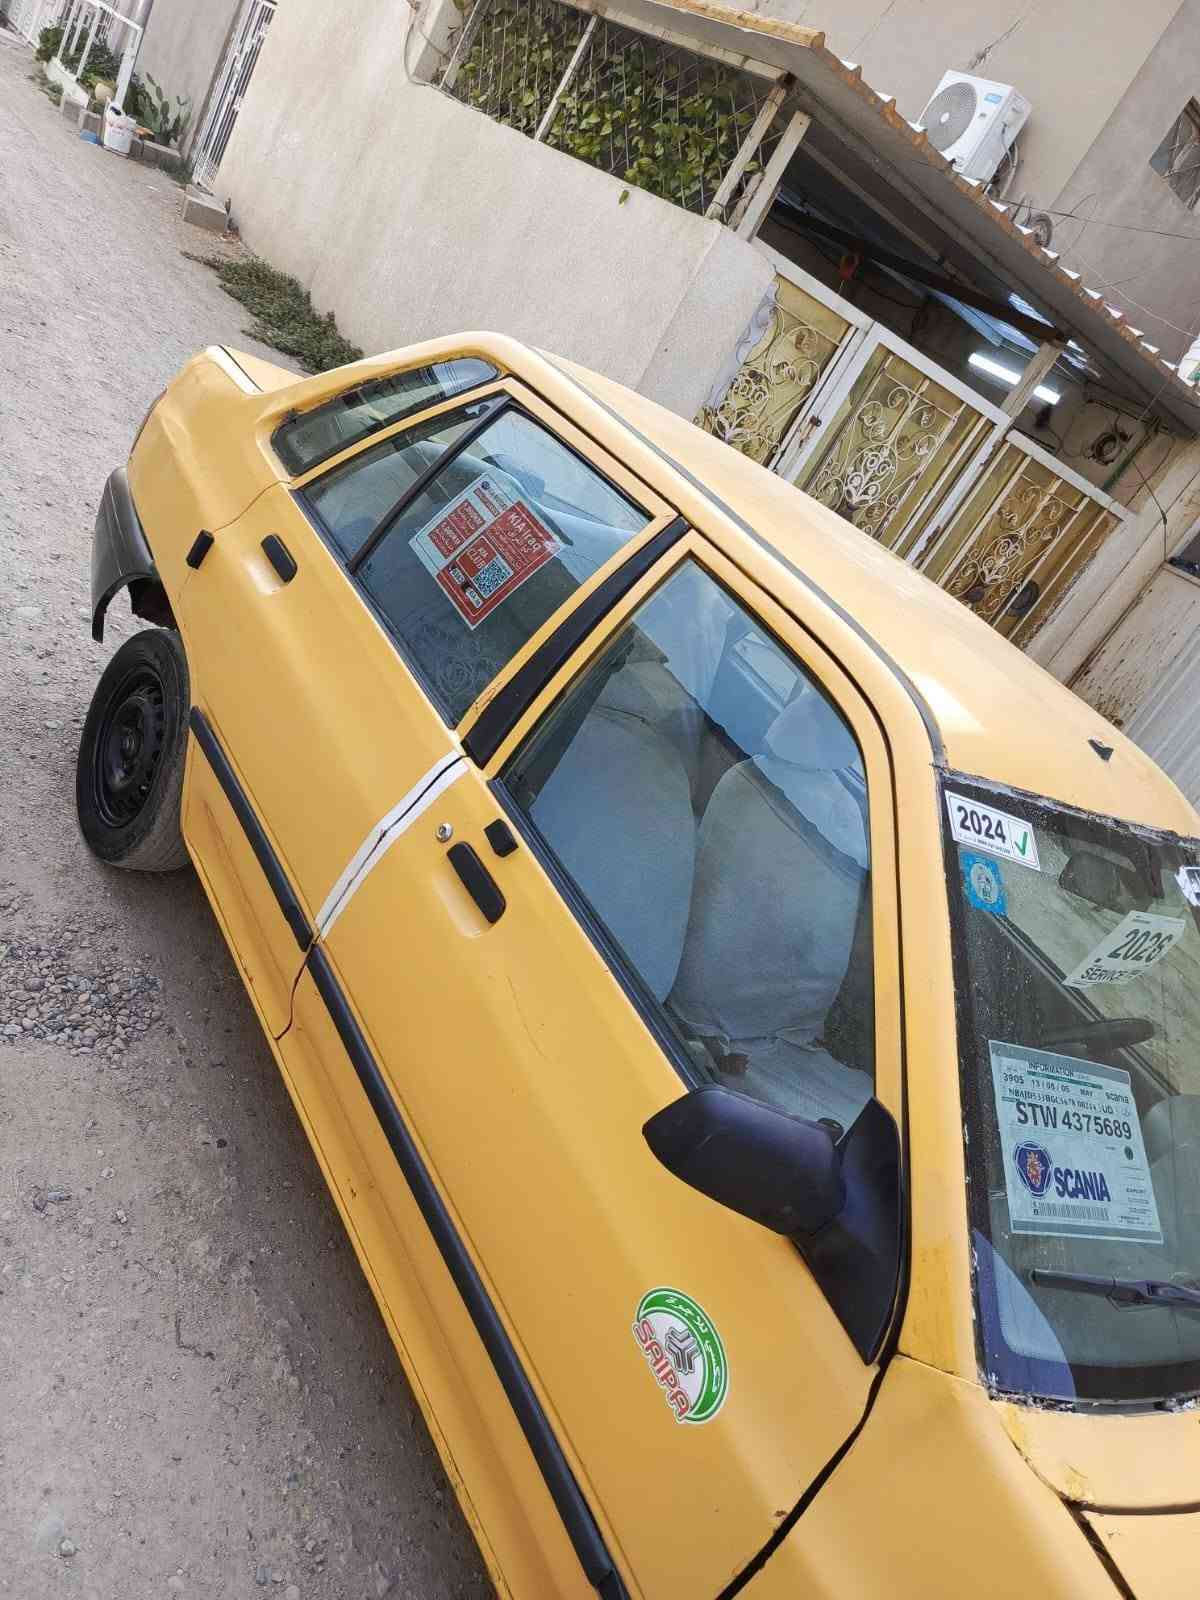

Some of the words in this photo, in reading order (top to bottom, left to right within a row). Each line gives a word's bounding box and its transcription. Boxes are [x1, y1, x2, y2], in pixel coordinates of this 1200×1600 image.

[957, 806, 1006, 843] 2024
[1107, 928, 1174, 963] 2026
[1016, 1101, 1058, 1130] STW
[1061, 1112, 1132, 1140] 4375689
[1053, 1166, 1111, 1202] SCANIA
[635, 1318, 691, 1421] SAIPA
